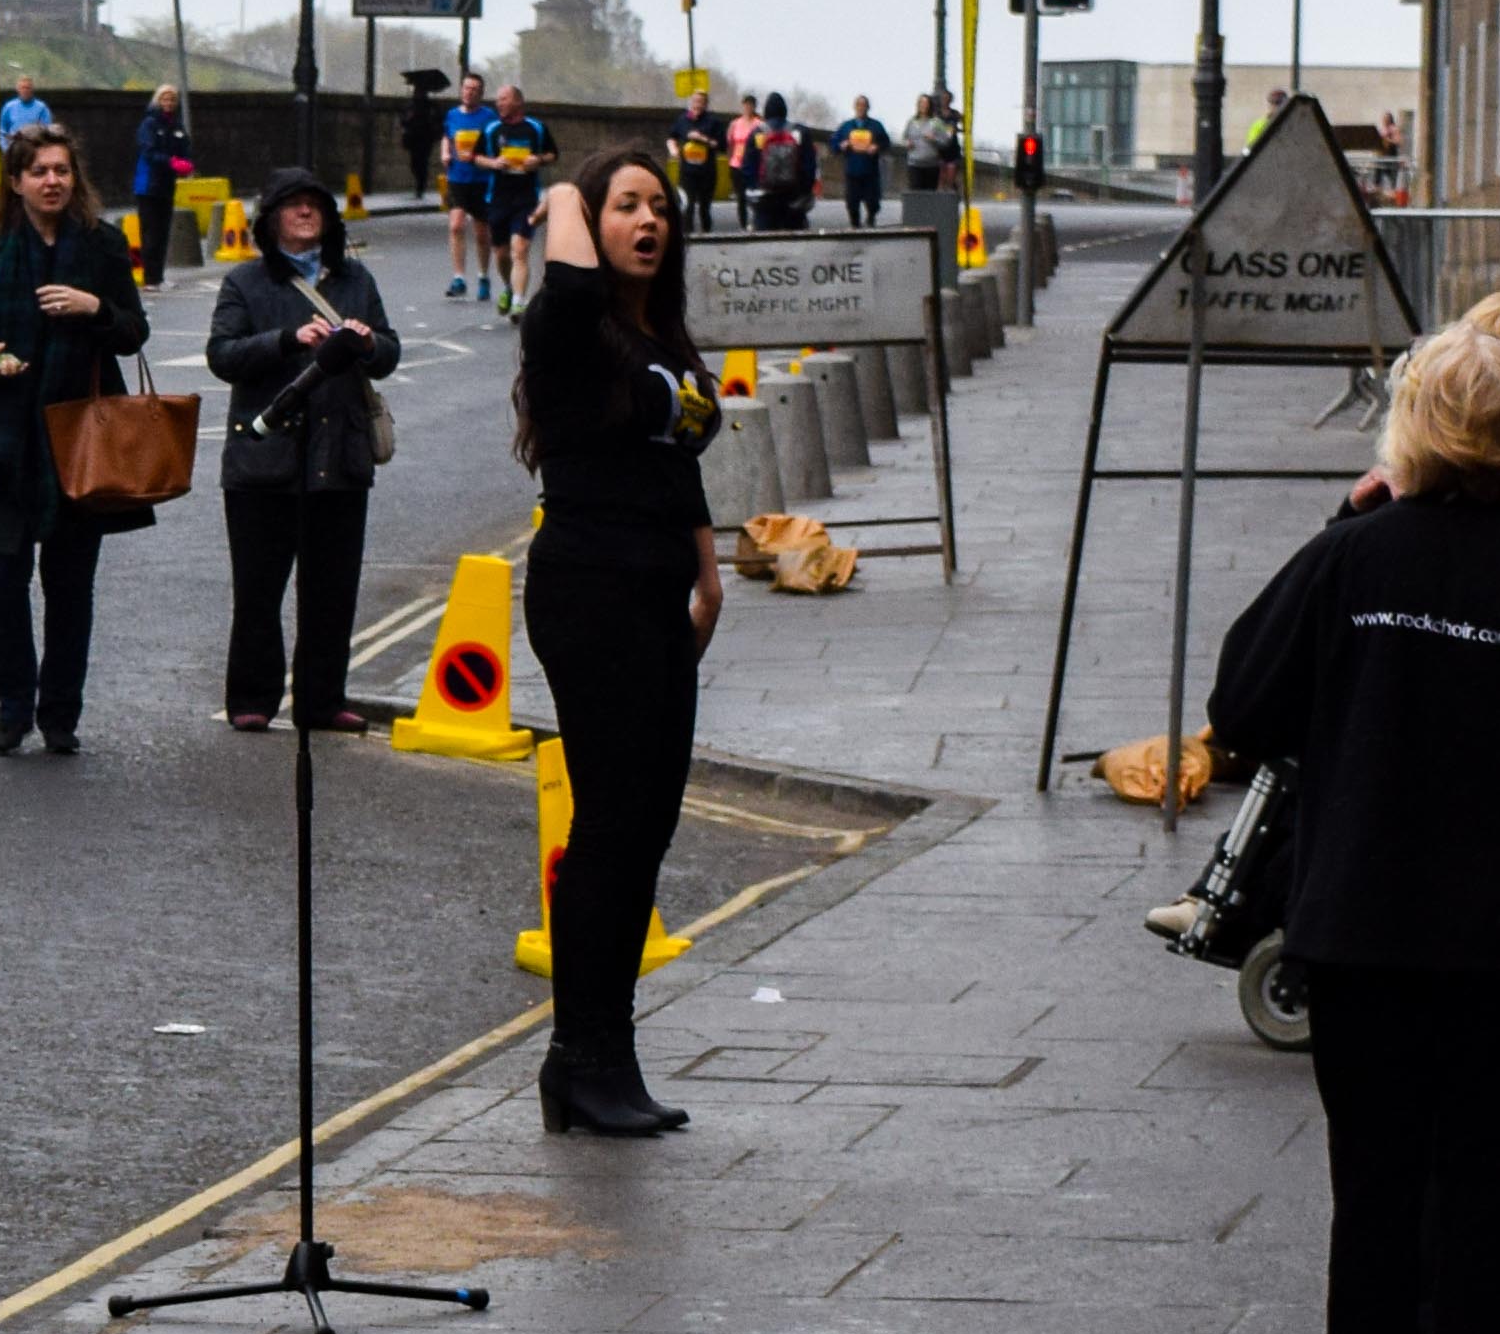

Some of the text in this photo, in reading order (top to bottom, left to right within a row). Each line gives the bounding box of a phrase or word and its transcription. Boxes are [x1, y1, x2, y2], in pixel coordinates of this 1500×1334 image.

[717, 262, 863, 288] CLASS ONE
[1298, 252, 1366, 280] ONE
[722, 296, 861, 314] TRAFFIC MGMT
[1177, 288, 1275, 311] TAFFIC
